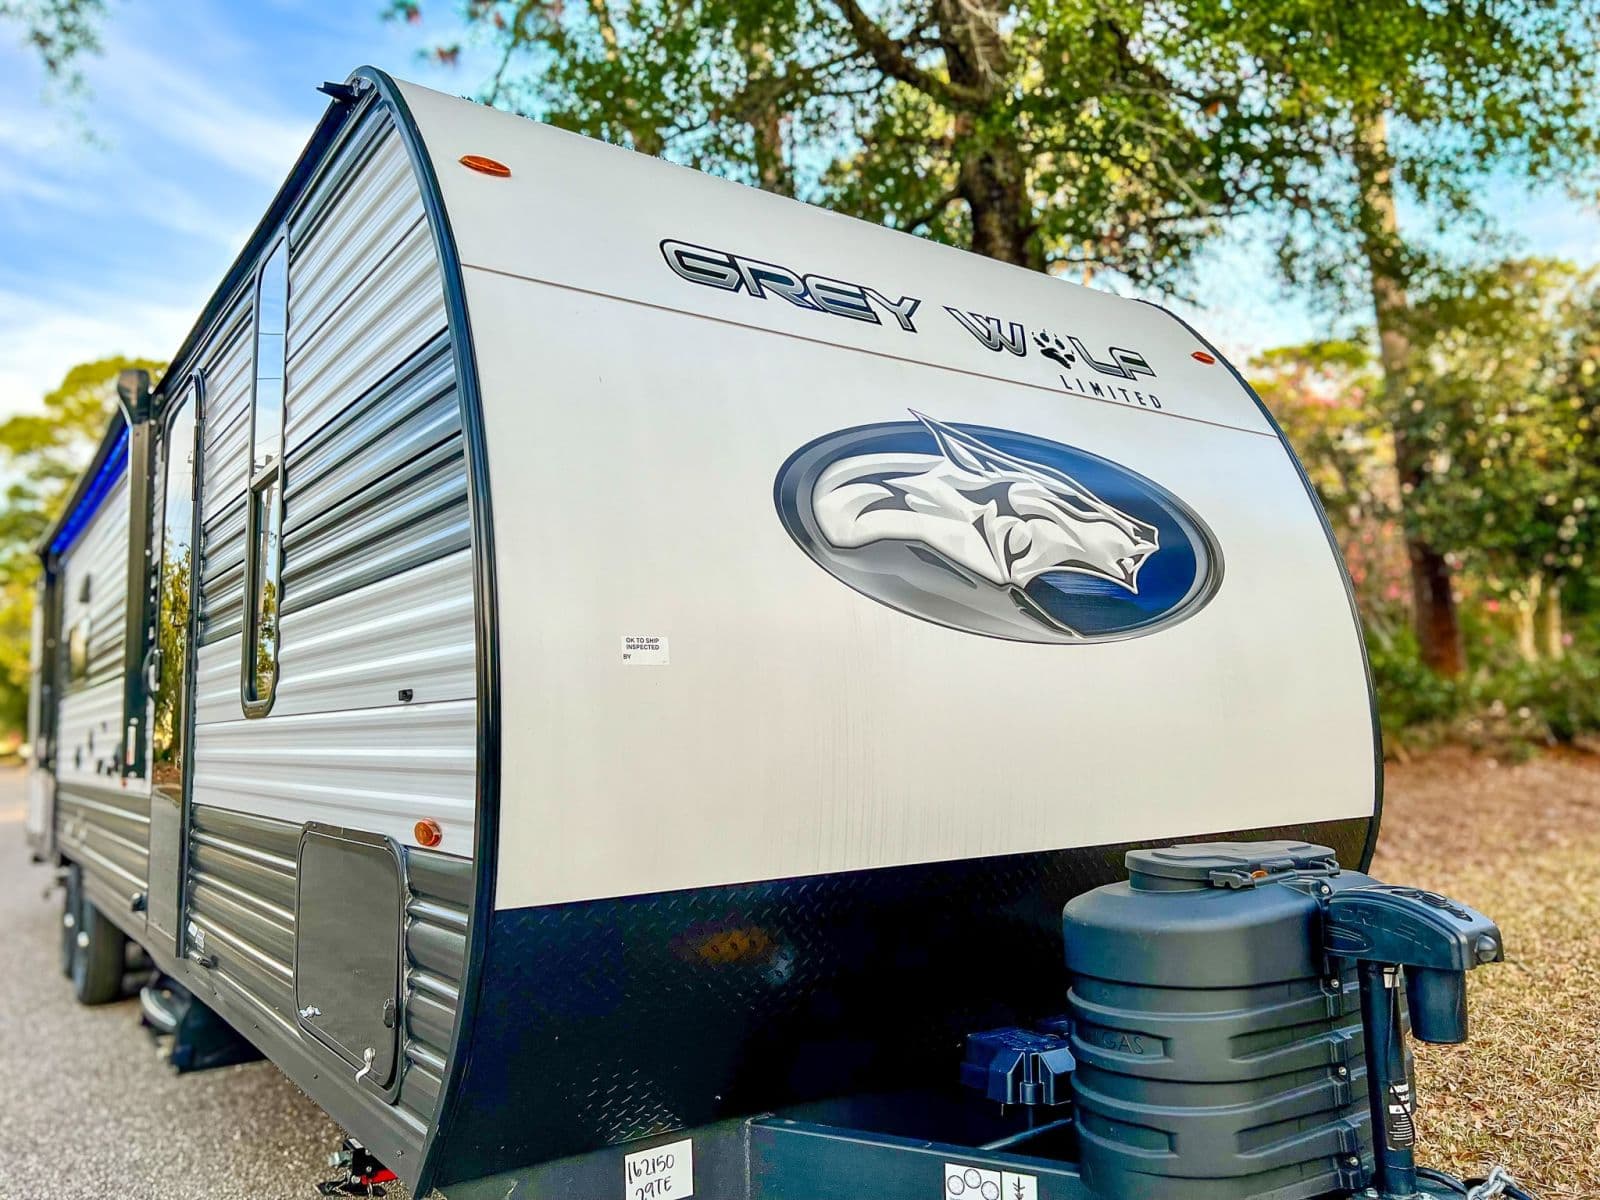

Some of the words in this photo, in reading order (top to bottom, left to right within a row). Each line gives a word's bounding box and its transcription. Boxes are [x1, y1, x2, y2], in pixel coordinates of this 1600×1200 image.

[659, 239, 922, 333] GREY
[943, 306, 1157, 381] WLF
[1060, 375, 1162, 409] LIMITED
[627, 1154, 675, 1185] 162150
